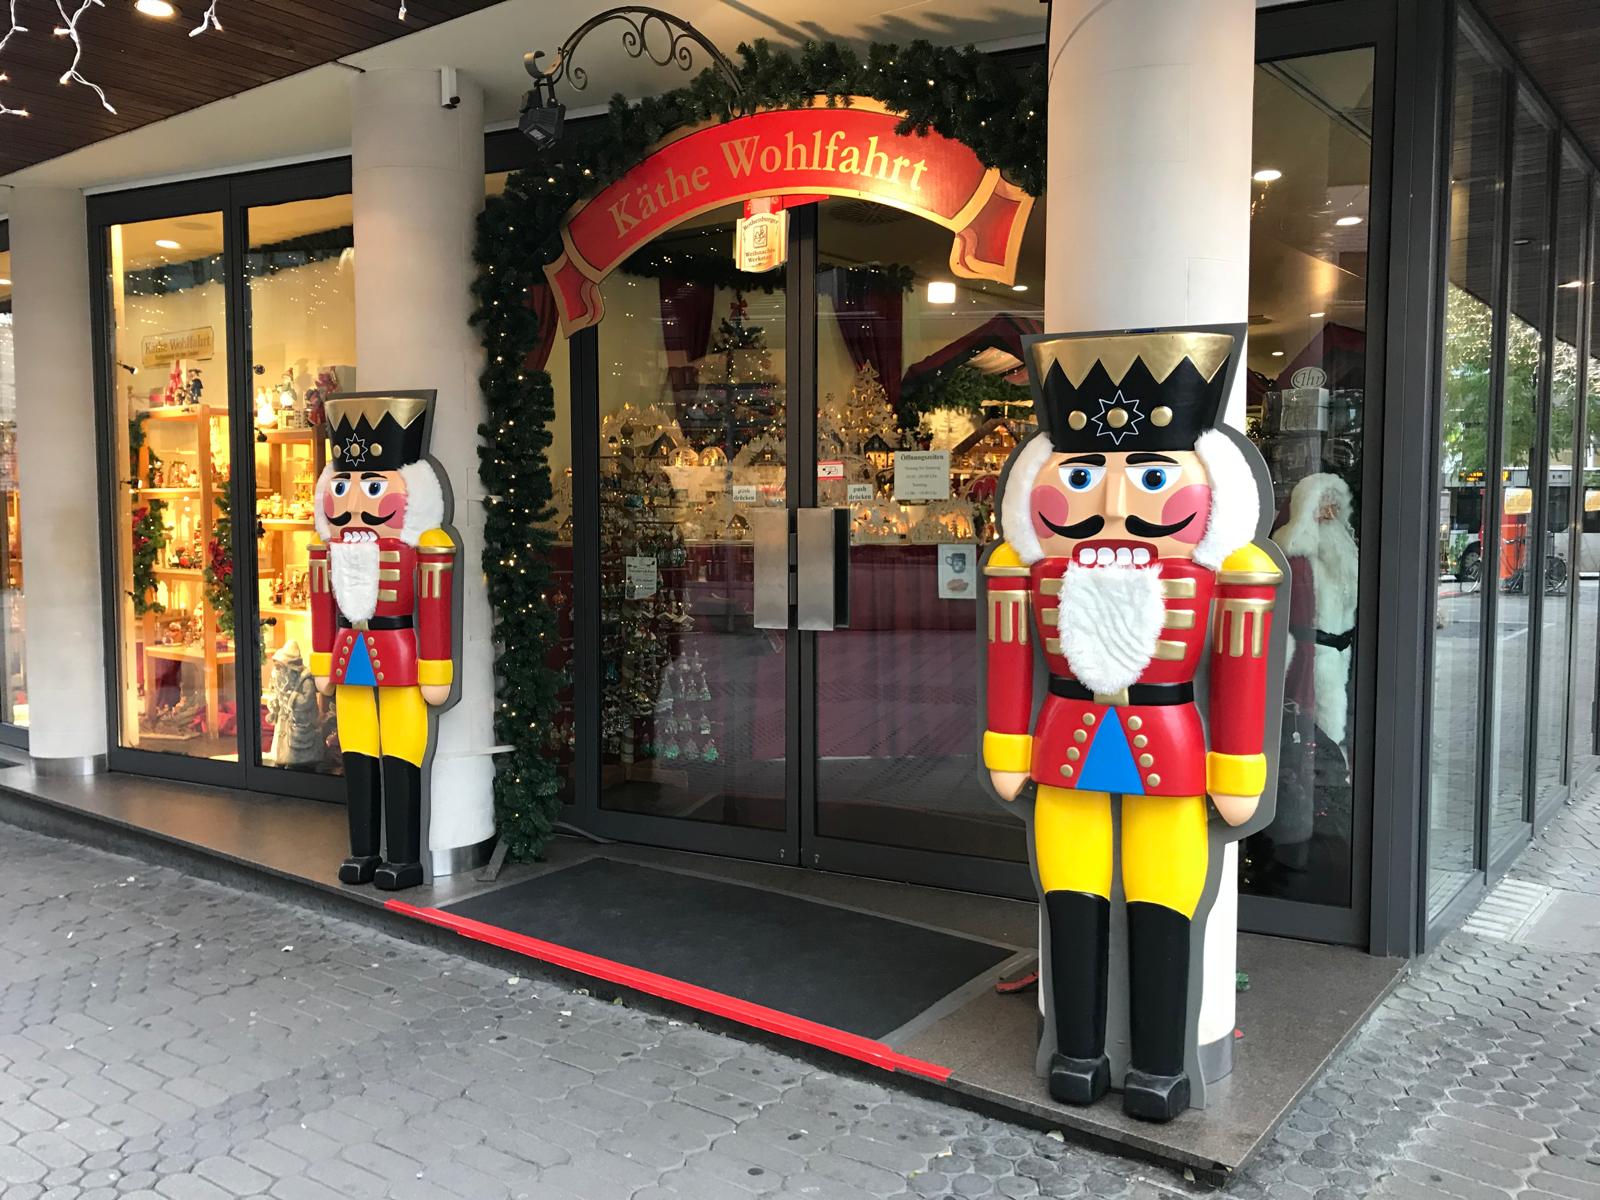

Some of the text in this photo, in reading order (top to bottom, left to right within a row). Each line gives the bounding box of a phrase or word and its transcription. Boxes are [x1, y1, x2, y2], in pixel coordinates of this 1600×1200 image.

[607, 130, 928, 240] Käthe Wohlfahrt
[853, 485, 867, 493] push
